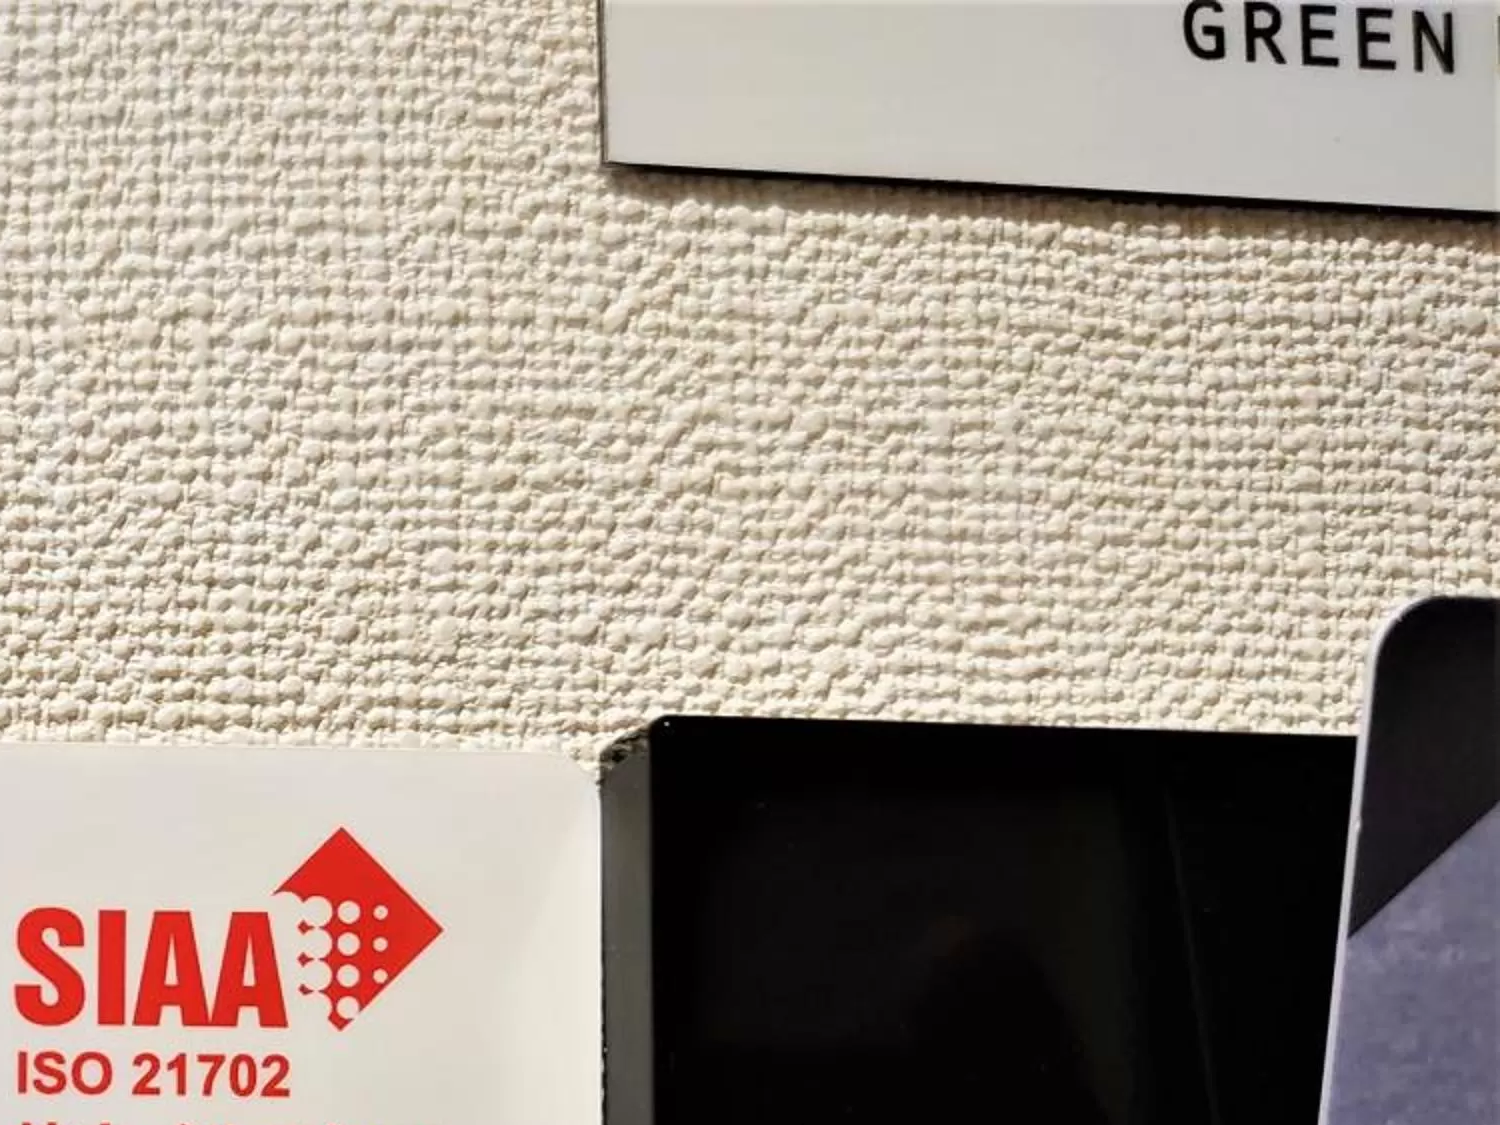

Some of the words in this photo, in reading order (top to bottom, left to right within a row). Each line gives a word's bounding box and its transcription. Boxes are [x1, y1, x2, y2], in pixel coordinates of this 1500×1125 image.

[1183, 0, 1456, 75] GREEN
[13, 907, 289, 1030] SIAA
[17, 1050, 114, 1097] ISO
[131, 1051, 291, 1099] 21702
